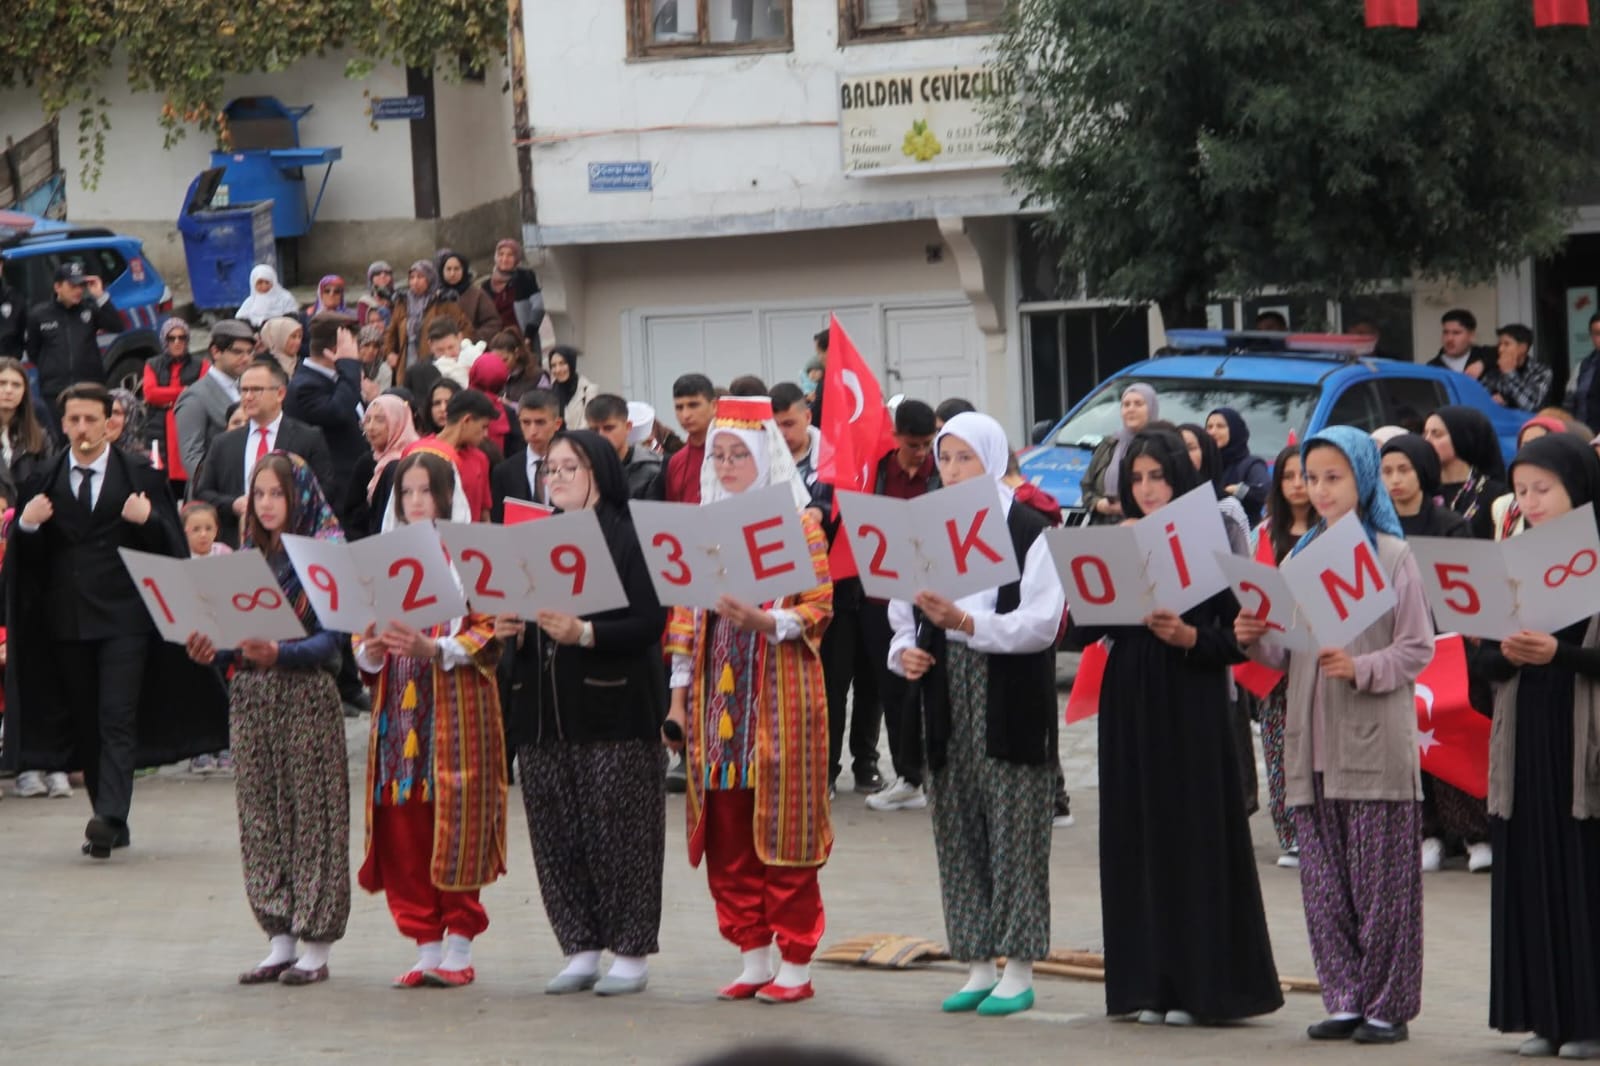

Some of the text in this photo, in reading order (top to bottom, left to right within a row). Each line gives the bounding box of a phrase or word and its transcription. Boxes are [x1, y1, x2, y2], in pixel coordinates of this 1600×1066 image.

[841, 77, 913, 110] BALDAN
[460, 543, 587, 599] 2 9
[651, 515, 796, 587] 3 E
[857, 508, 1004, 580] 2 K
[143, 577, 175, 623] 1
[307, 557, 438, 612] 9 2
[1239, 541, 1386, 632] 2 M
[1434, 562, 1481, 616] 5
